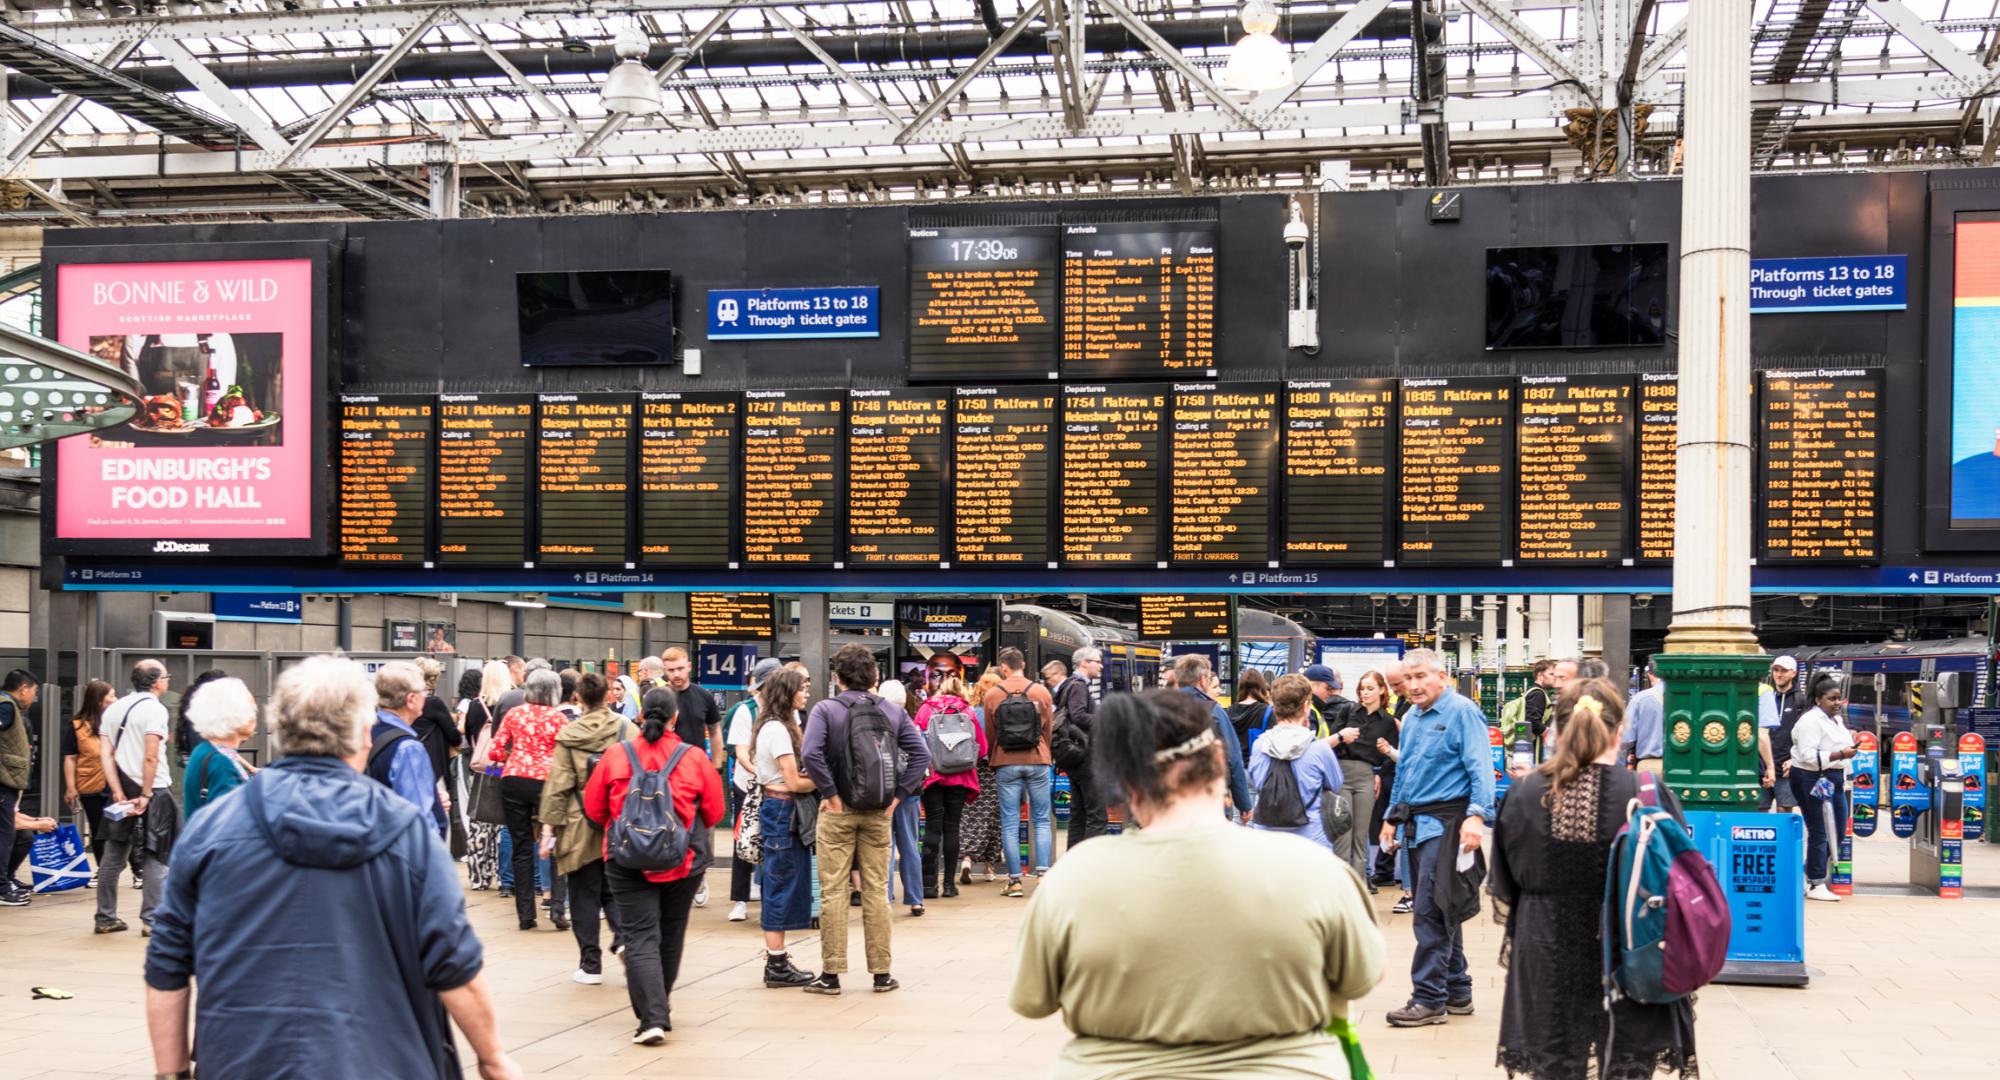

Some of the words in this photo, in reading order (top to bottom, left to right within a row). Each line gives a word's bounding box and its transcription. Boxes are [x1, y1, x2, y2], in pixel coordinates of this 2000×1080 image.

[950, 240, 1003, 262] 17:39
[1750, 270, 1825, 282] Platforms
[1830, 267, 1848, 280] 13
[1853, 268, 1870, 279] to
[1875, 266, 1894, 278] 18
[94, 282, 184, 304] BONNIE
[193, 280, 210, 303] &
[216, 279, 278, 301] WILD
[1751, 286, 1806, 301] Through
[1813, 286, 1852, 297] ticket
[1855, 286, 1893, 298] gates
[748, 299, 810, 310] Platforms
[814, 297, 830, 309] 13
[833, 298, 848, 309] to
[852, 296, 868, 308] 18
[748, 315, 795, 327] Through
[800, 314, 833, 325] ticket
[836, 315, 867, 326] gates
[1522, 375, 1566, 384] Departures
[1288, 380, 1332, 390] Departures
[1329, 392, 1376, 404] Platform
[1444, 391, 1492, 401] Platform
[1568, 388, 1618, 398] Platform
[994, 399, 1038, 409] Platform
[1103, 397, 1148, 407] Platform
[1213, 395, 1259, 405] Platform
[473, 406, 515, 415] Platform
[576, 405, 618, 414] Platform
[682, 404, 724, 413] Platform
[782, 402, 825, 412] Platform
[888, 401, 931, 410] Platform
[1603, 402, 1616, 412] St
[376, 407, 417, 416] Platform
[1143, 411, 1158, 420] via
[1175, 410, 1212, 421] Glasgow
[1214, 409, 1251, 419] Central
[1254, 409, 1270, 418] via
[1288, 408, 1331, 418] Glasgow
[1335, 405, 1368, 419] Queen
[1372, 406, 1385, 416] St
[1404, 406, 1453, 416] Dunblane
[442, 419, 494, 428] Tweedbank
[542, 419, 580, 429] Glasgow
[582, 419, 612, 428] Queen
[615, 418, 627, 428] St
[747, 416, 801, 425] Glenrothes
[852, 415, 886, 426] Glasgow
[889, 414, 924, 424] Central
[926, 414, 941, 424] via
[957, 414, 994, 423] Dundee
[102, 458, 271, 480] EDINBURGH'S
[112, 487, 188, 508] FOOD
[196, 487, 261, 508] HALL
[154, 542, 210, 552] JCDecaux
[642, 574, 654, 582] 14
[1260, 574, 1302, 582] Platform
[1305, 574, 1318, 582] 15
[1944, 573, 1992, 582] Platform
[831, 605, 856, 615] ckets
[924, 615, 968, 623] ROCKSTAR
[908, 632, 982, 643] STORMZY
[706, 653, 736, 676] 14
[744, 655, 756, 676] 14
[1734, 829, 1776, 840] METRO
[1732, 845, 1747, 853] PICK
[1759, 845, 1776, 853] YOUR
[1733, 854, 1776, 875] FREE
[1732, 876, 1776, 884] NEWSPAPER
